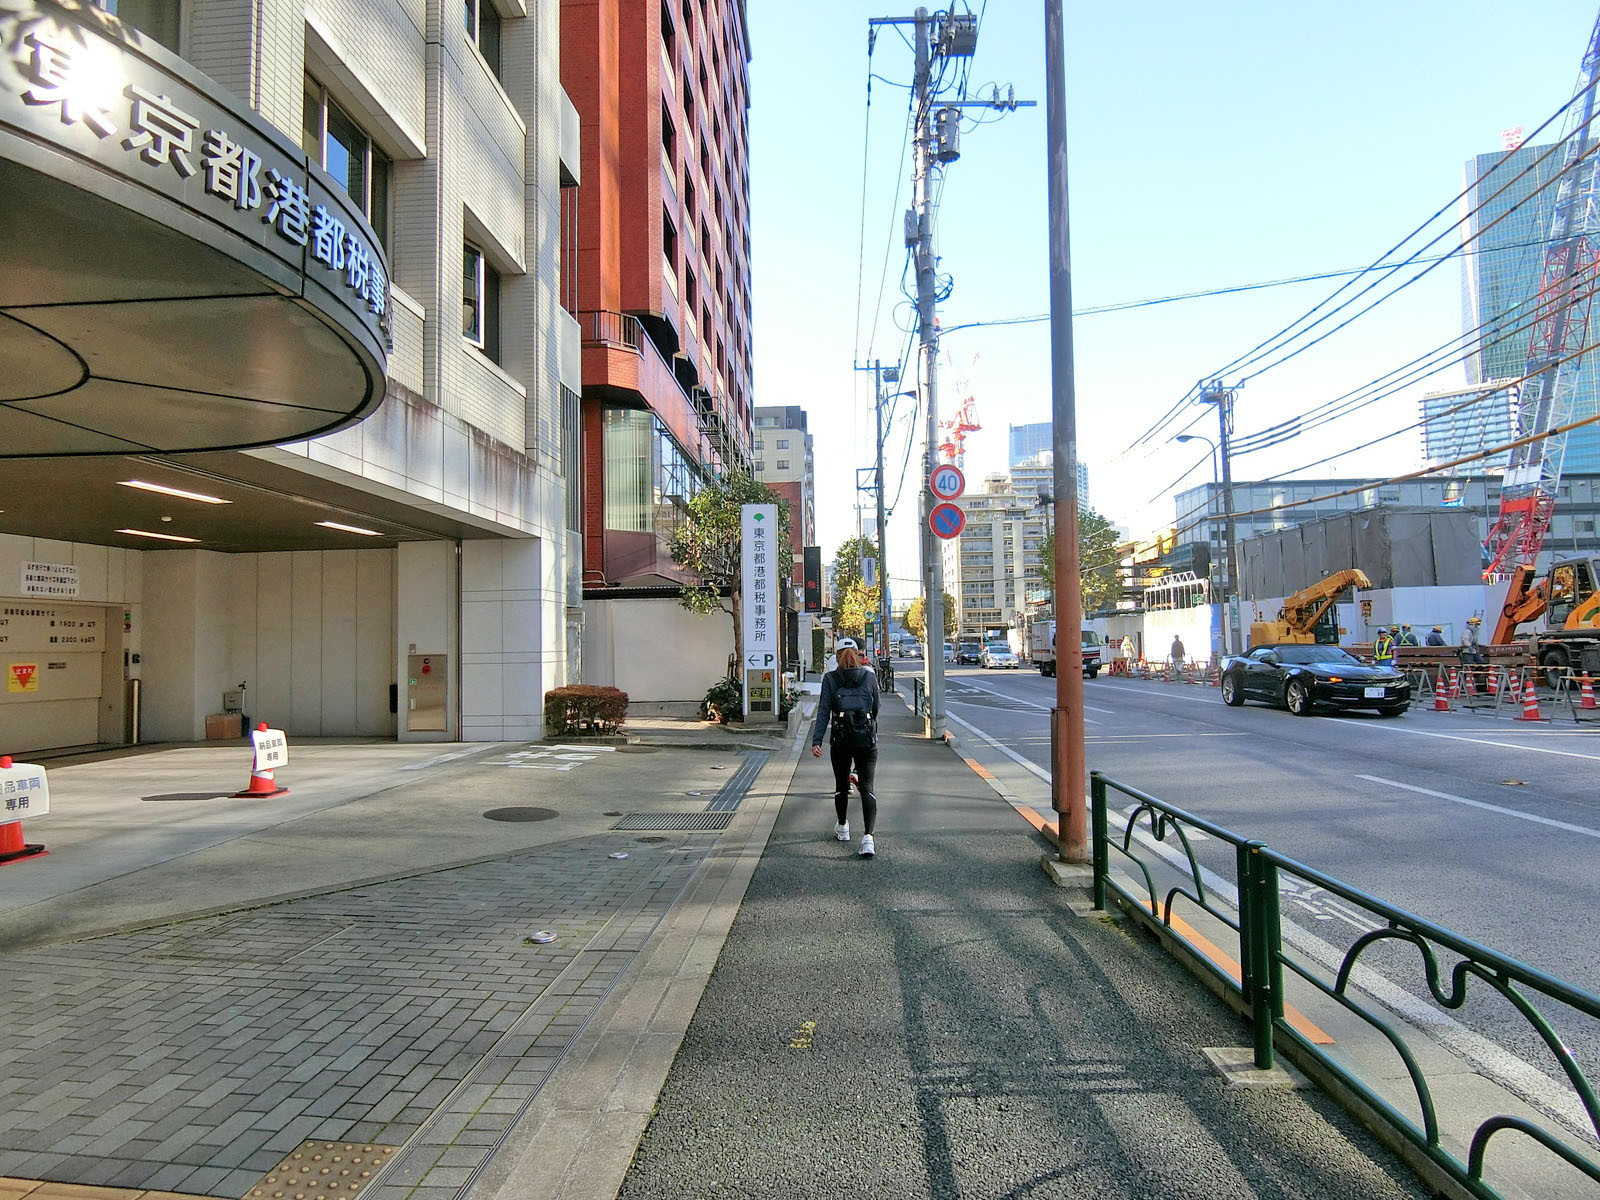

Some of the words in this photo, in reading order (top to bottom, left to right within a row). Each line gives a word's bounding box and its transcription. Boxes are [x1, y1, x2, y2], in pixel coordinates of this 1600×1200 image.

[938, 475, 957, 491] 40
[753, 527, 766, 642] 東京都港都税事務所
[764, 654, 774, 667] P
[750, 687, 771, 699] 空車
[0, 777, 40, 795] 品車両
[5, 796, 30, 810] 専用
